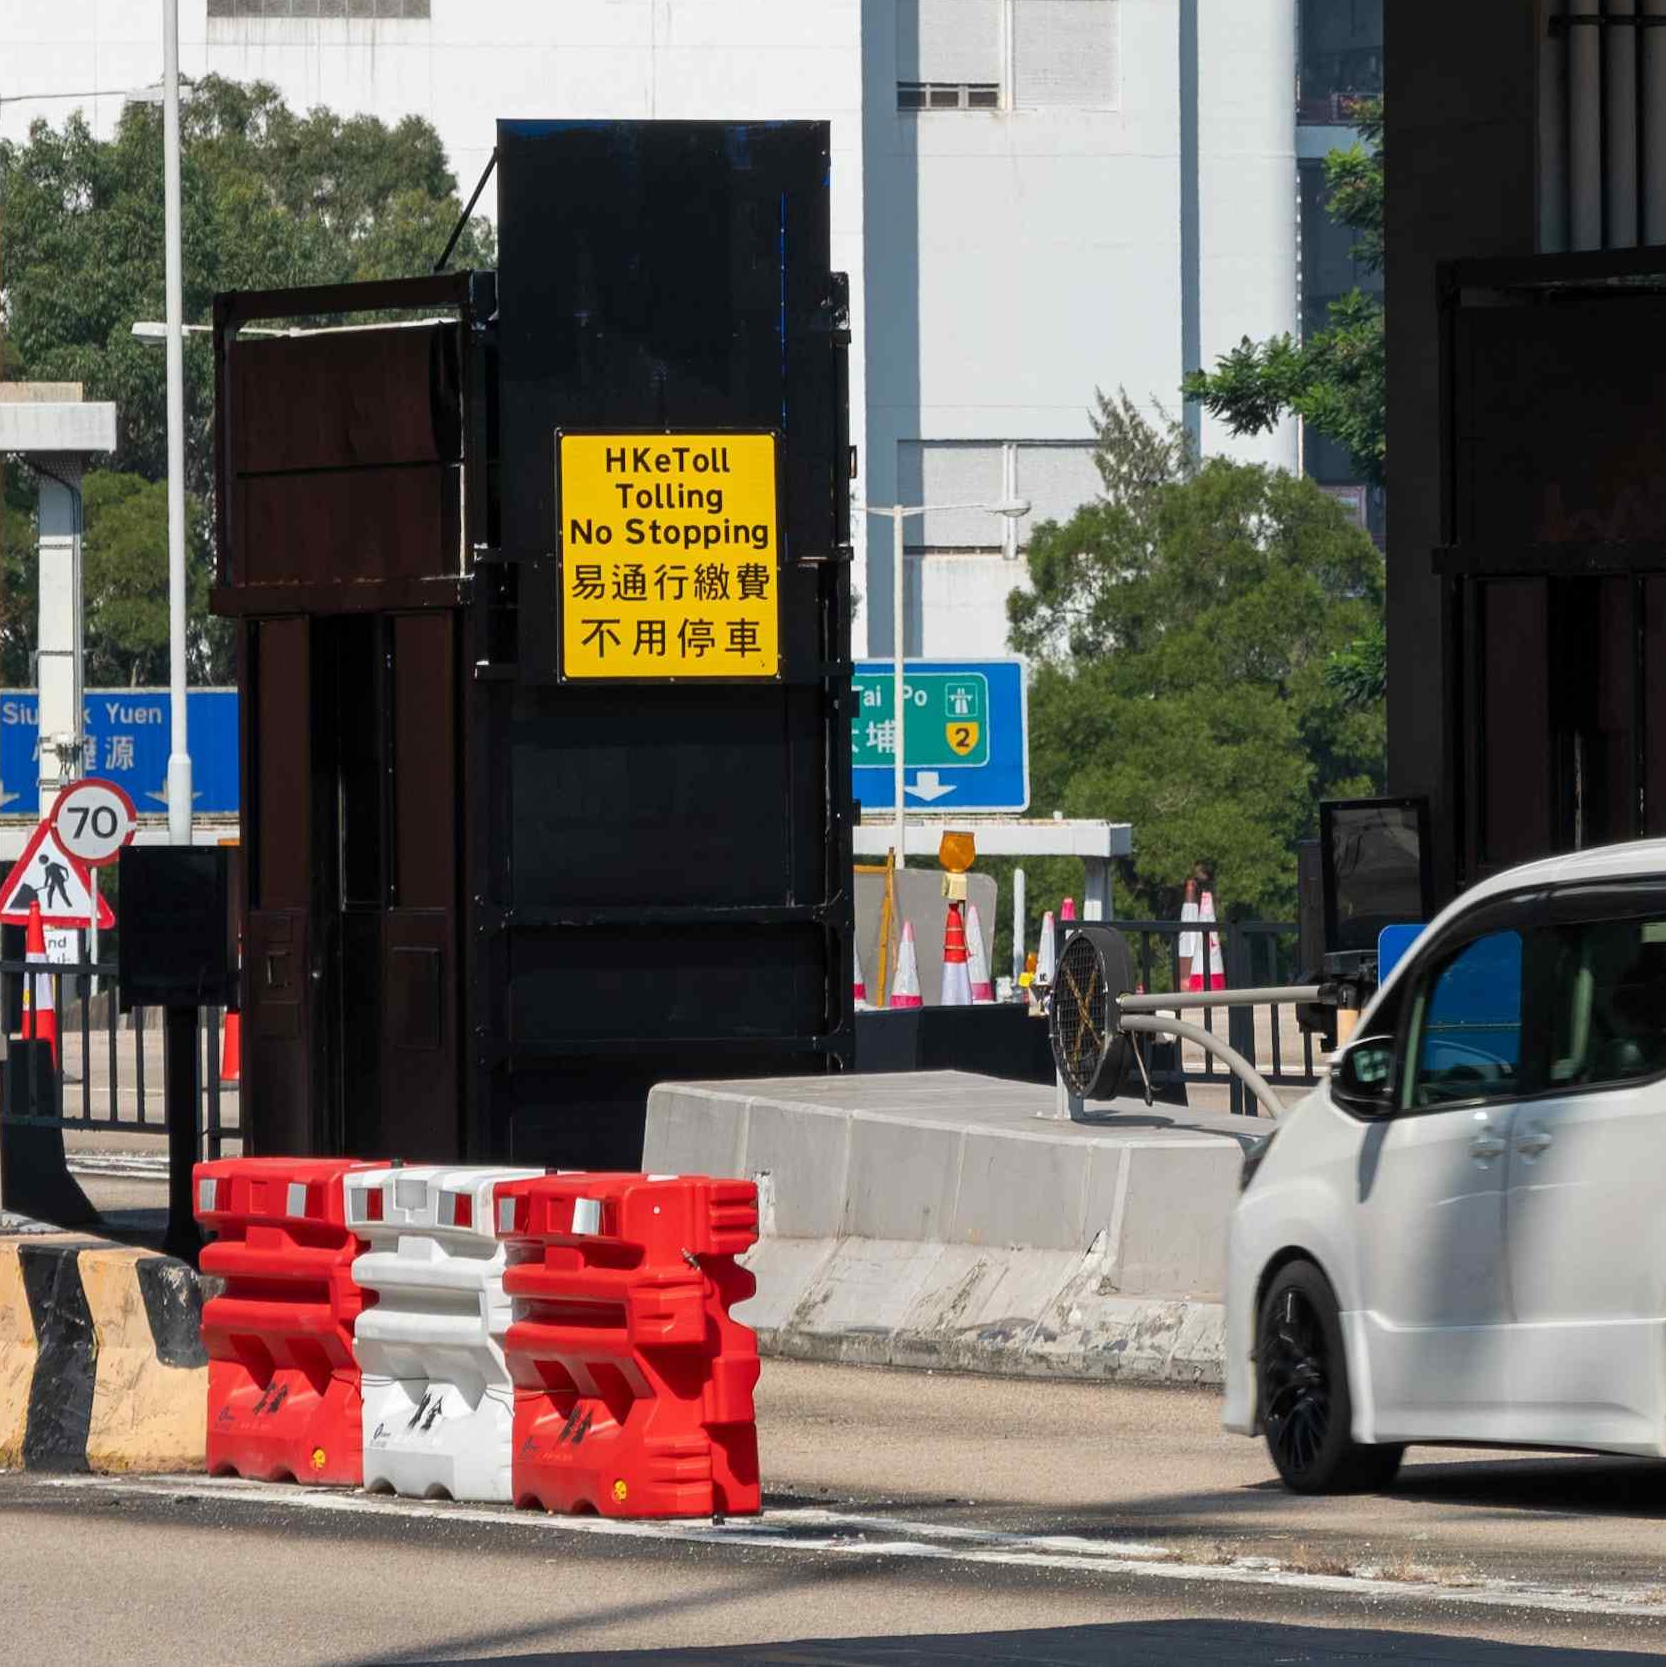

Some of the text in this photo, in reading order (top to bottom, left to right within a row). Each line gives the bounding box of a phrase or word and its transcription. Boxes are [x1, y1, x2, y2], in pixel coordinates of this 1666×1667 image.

[605, 447, 731, 473] HKeToll
[615, 482, 723, 515] Tolling
[570, 518, 769, 550] No Stopping
[572, 562, 770, 602] 易通行繳費
[581, 617, 762, 659] 不用停車
[105, 702, 162, 724] Yuen
[954, 727, 974, 750] 2
[67, 805, 118, 839] 70
